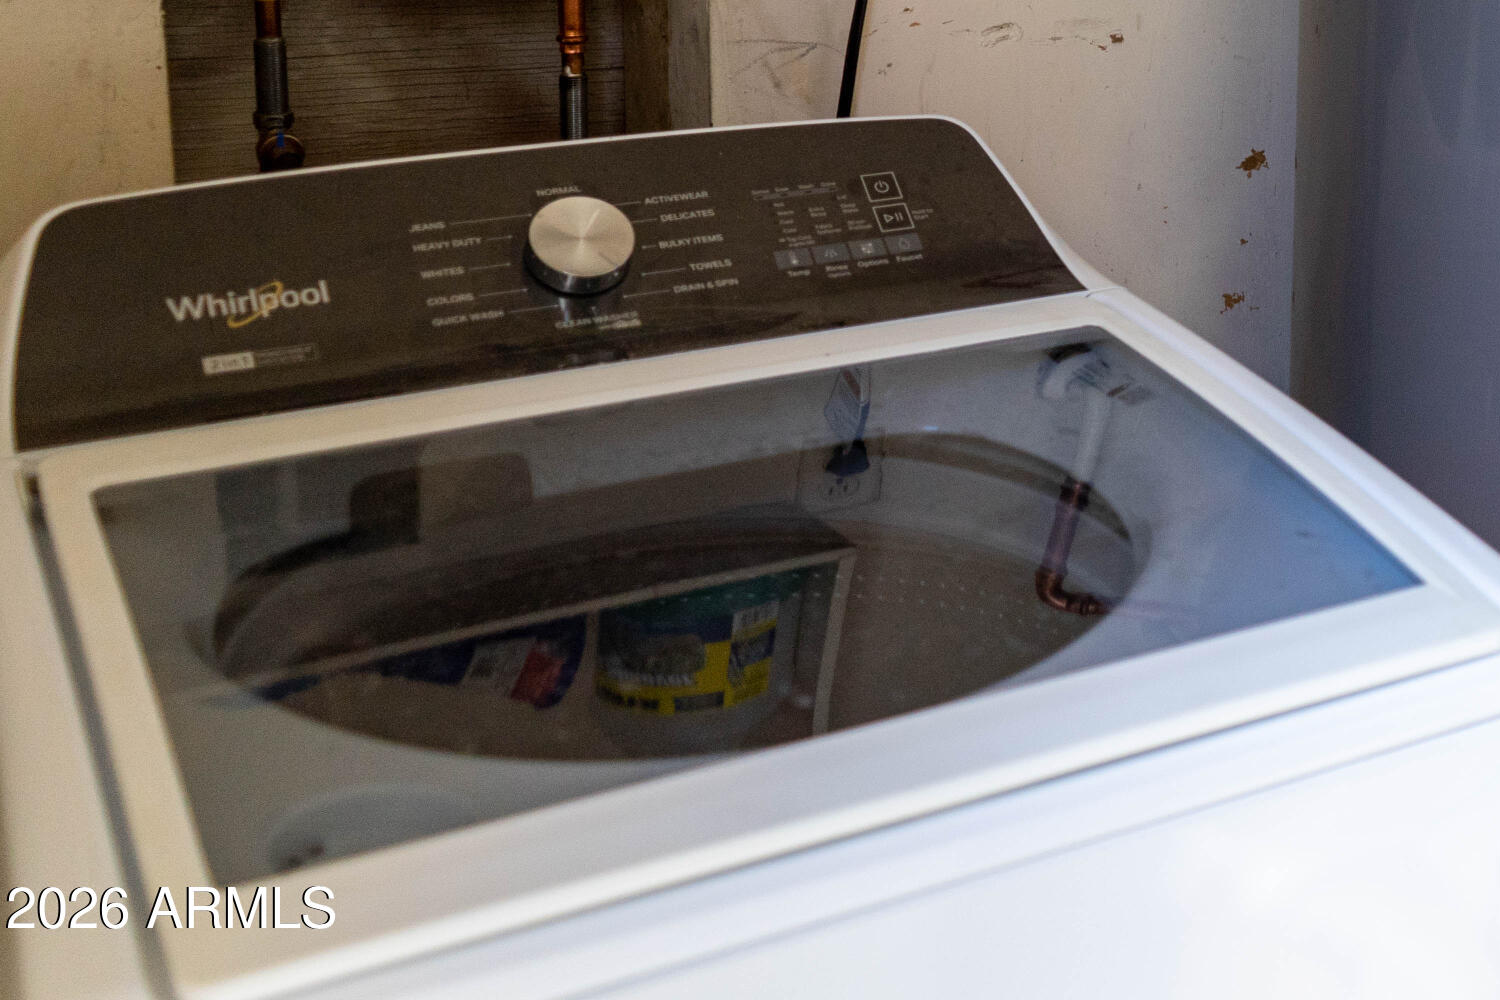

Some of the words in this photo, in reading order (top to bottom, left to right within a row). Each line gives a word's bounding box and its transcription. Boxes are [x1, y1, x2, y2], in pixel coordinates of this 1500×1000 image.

[536, 185, 582, 197] NORMAL
[644, 190, 709, 205] ACTIVEWEAR
[660, 209, 715, 223] DELICATES
[409, 221, 446, 233] JEANS
[412, 240, 450, 252] HEAVY
[451, 237, 482, 248] DUTY
[658, 237, 692, 250] BULKY
[692, 233, 724, 245] ITEMS
[420, 265, 465, 279] WHITES
[689, 258, 732, 272] TOWELS
[672, 282, 705, 295] DRAIN
[714, 277, 739, 289] SPIN
[165, 279, 331, 322] Whirlpool
[426, 292, 475, 306] COLORS
